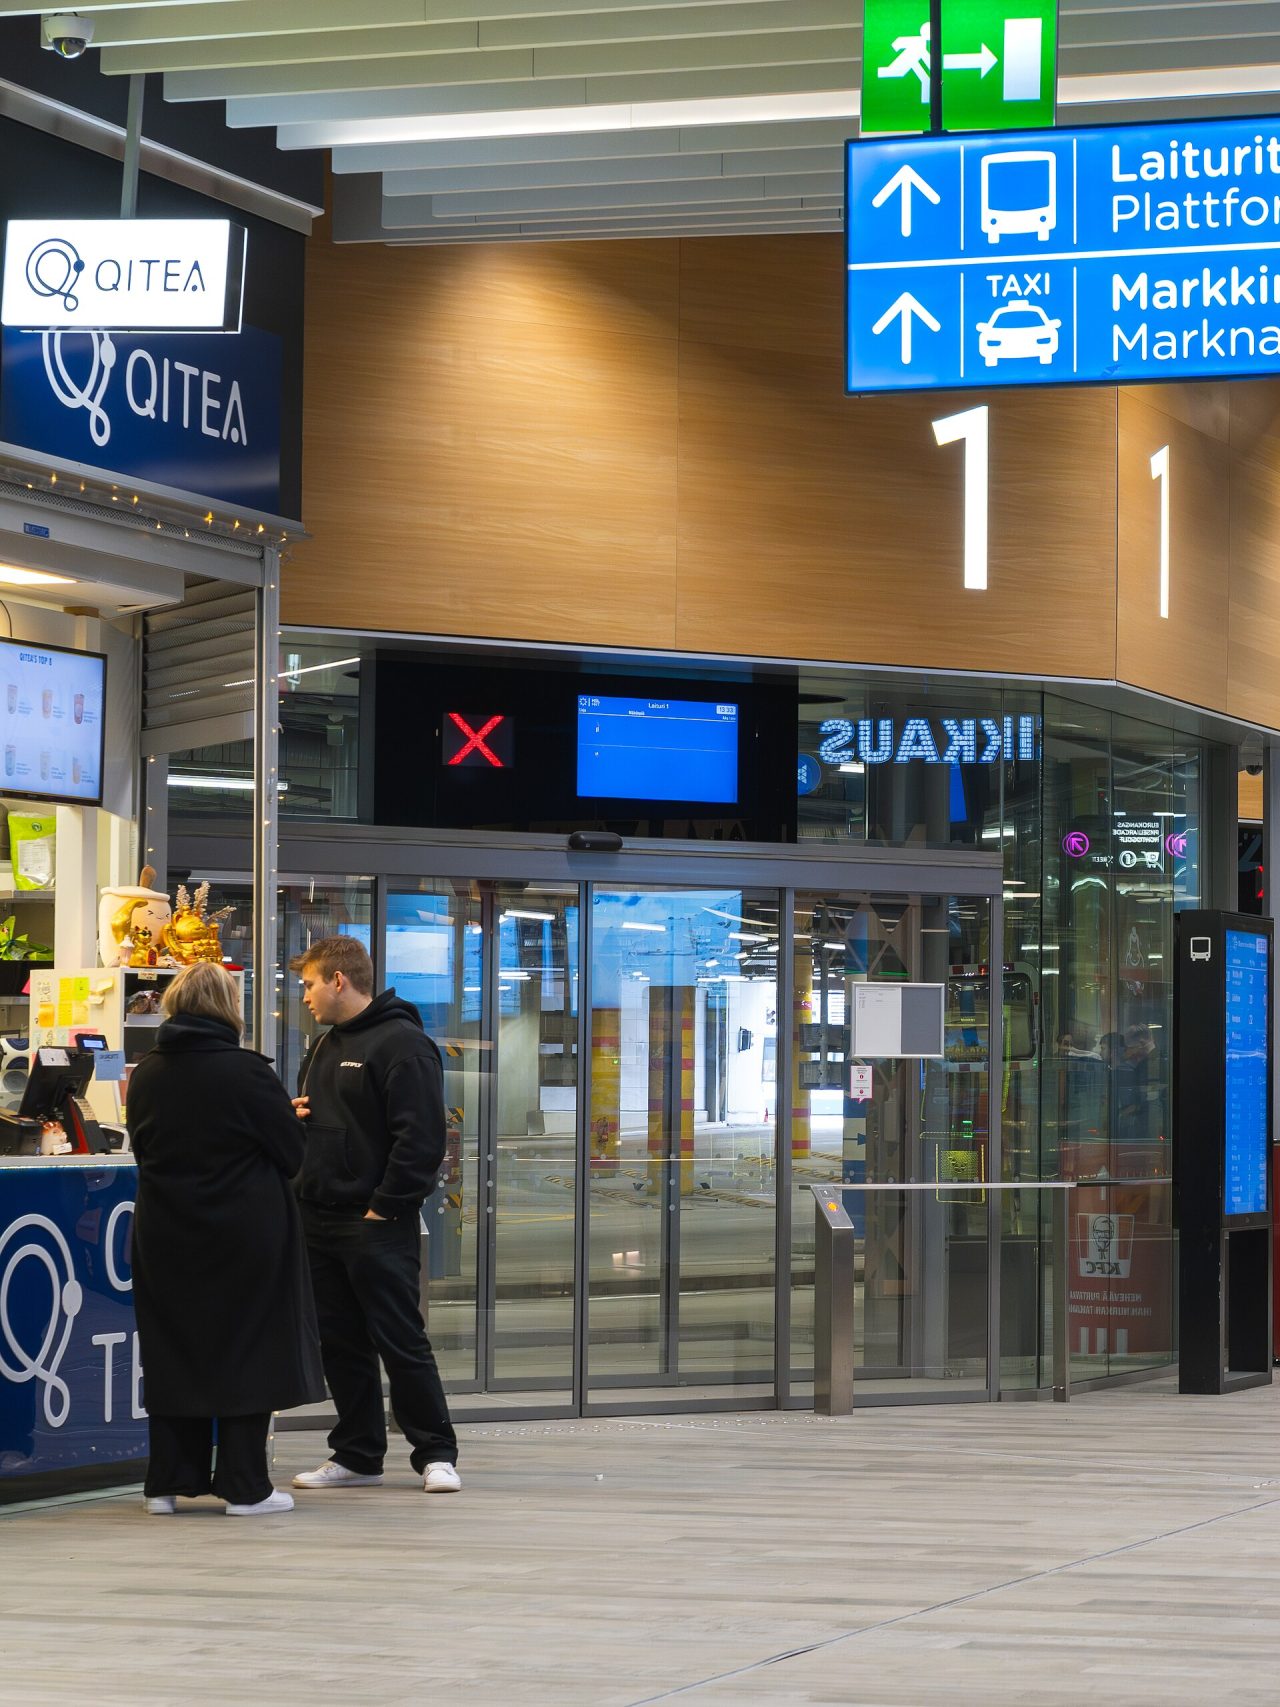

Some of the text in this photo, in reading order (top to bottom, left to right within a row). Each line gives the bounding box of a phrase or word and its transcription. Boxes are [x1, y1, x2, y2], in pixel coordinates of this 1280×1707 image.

[95, 259, 206, 292] QITEA
[986, 274, 1051, 297] TAXI
[125, 348, 248, 447] QITEA
[932, 404, 989, 591] 1
[1150, 443, 1171, 620] 1
